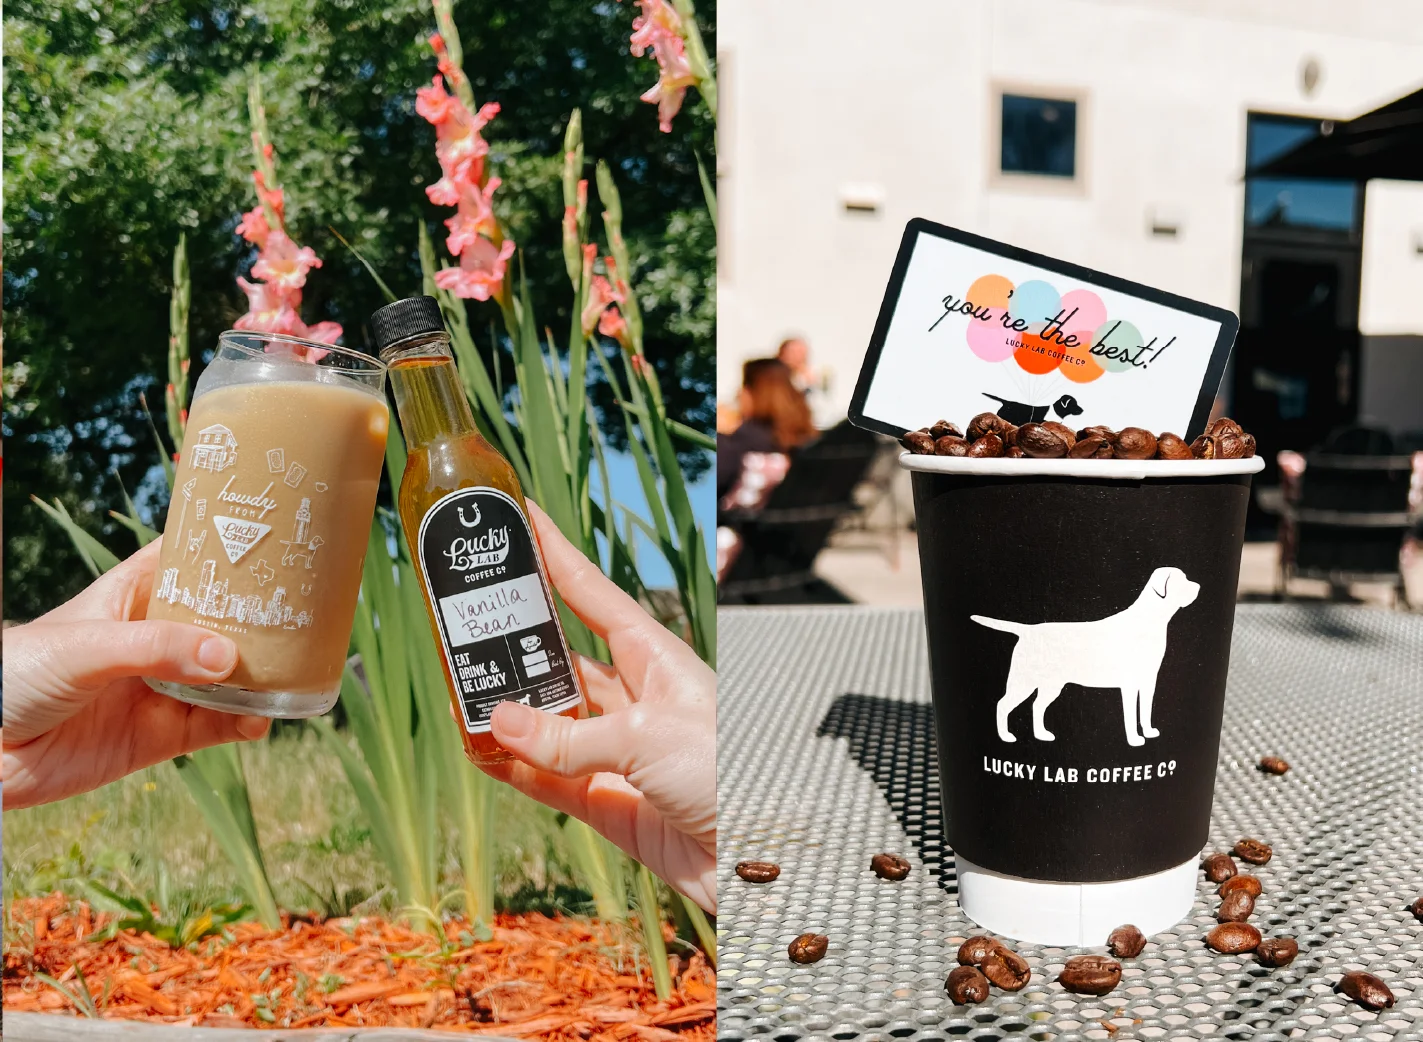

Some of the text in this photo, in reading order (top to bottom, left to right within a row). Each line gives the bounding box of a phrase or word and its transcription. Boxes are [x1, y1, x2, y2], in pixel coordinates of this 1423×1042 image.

[928, 289, 1176, 369] you're the best!
[1005, 337, 1030, 349] LUCKY
[1031, 345, 1046, 354] LAB
[1047, 349, 1075, 363] COFFEE
[217, 474, 277, 520] howdy
[229, 505, 256, 518] FROM
[221, 522, 261, 541] Lucky
[225, 543, 248, 552] COFFEE
[442, 524, 510, 572] Lucky
[476, 552, 500, 565] LAB
[464, 568, 495, 583] COFFEE
[451, 587, 528, 620] Vanilla
[461, 613, 521, 639] Bean
[454, 652, 471, 667] EAT
[458, 660, 500, 680] DRINK &
[462, 672, 507, 694] BE LUCKY
[983, 755, 1036, 781] LUCKY
[1043, 766, 1079, 783] LAB
[1086, 764, 1153, 783] COFFEE
